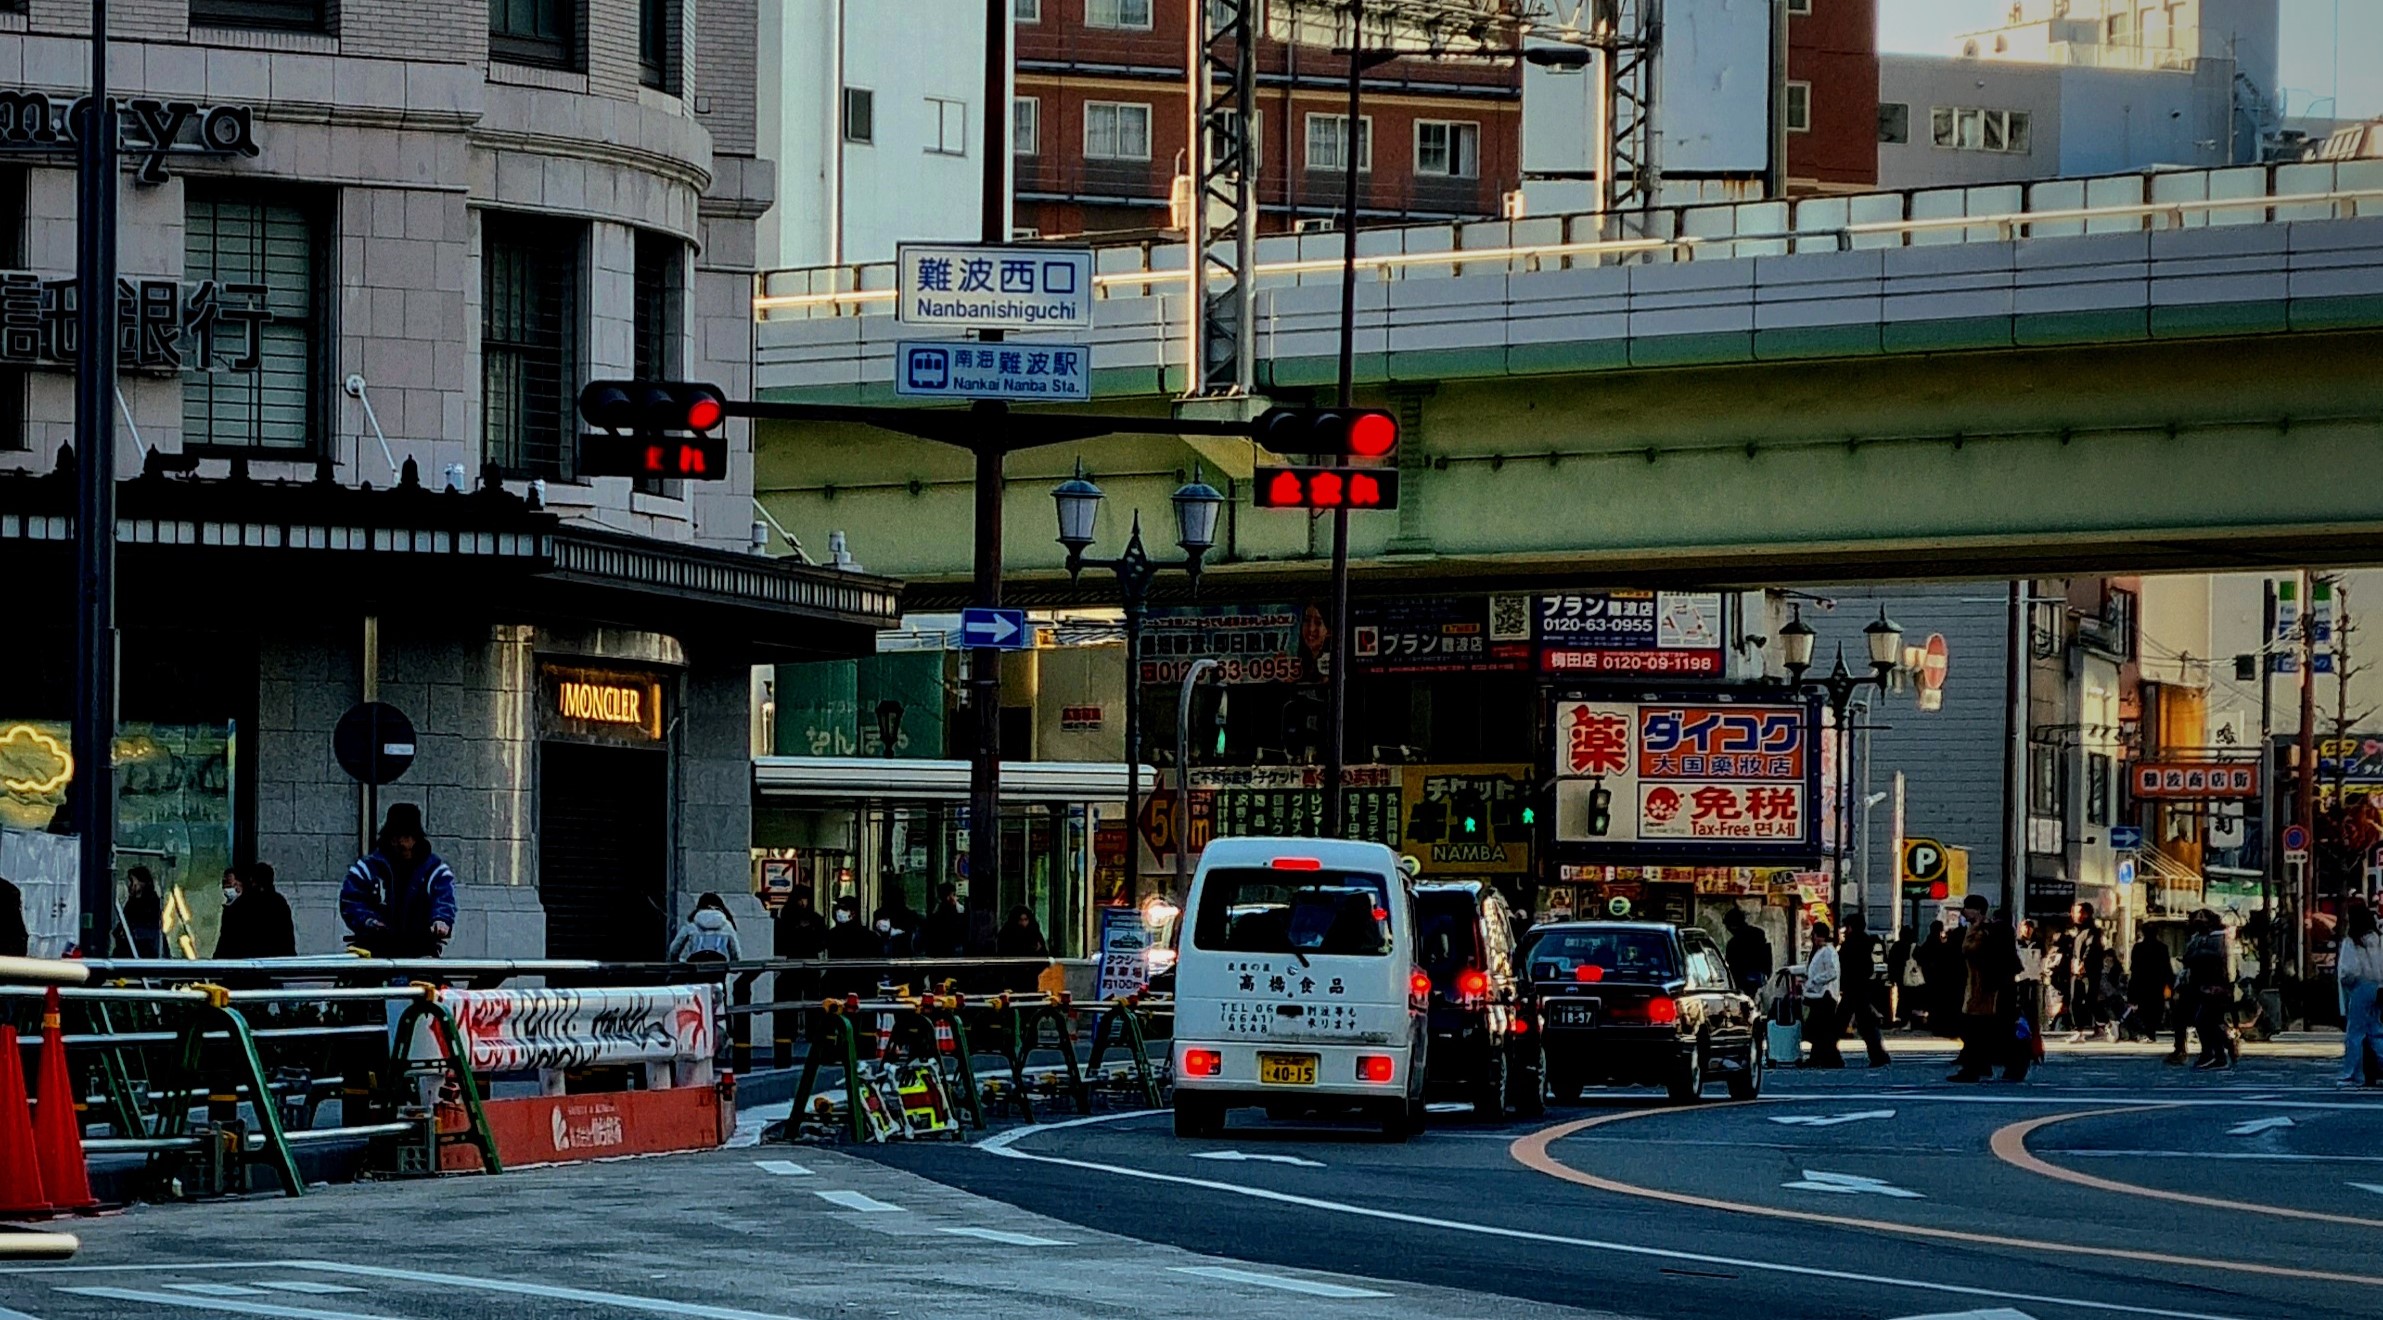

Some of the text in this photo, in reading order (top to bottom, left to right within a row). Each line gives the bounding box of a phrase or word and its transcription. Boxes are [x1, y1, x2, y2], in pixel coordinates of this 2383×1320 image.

[0, 90, 259, 183] mya
[917, 257, 1075, 294] 難波西口
[918, 298, 1076, 322] Nanbanishiguchi
[954, 350, 1078, 376] 南海難波駅
[953, 377, 1080, 393] Nankai Nanba Sta.
[1543, 618, 1653, 632] 0120-63-0955
[1602, 657, 1712, 671] 0120-09-1198
[561, 682, 641, 723] MONCLER
[1569, 704, 1800, 775] 薬 ダイコク
[1690, 786, 1798, 821] 免税
[1691, 822, 1750, 836] Tax-Free
[1754, 823, 1795, 836] 면세
[1433, 846, 1506, 861] NAMBA
[1916, 847, 1937, 875] P
[1107, 955, 1144, 965] タクシー
[1220, 1002, 1274, 1014] TEL 06
[1220, 1012, 1275, 1024] (6641)
[1228, 1023, 1268, 1034] 4548
[1273, 1067, 1313, 1082] 40-15
